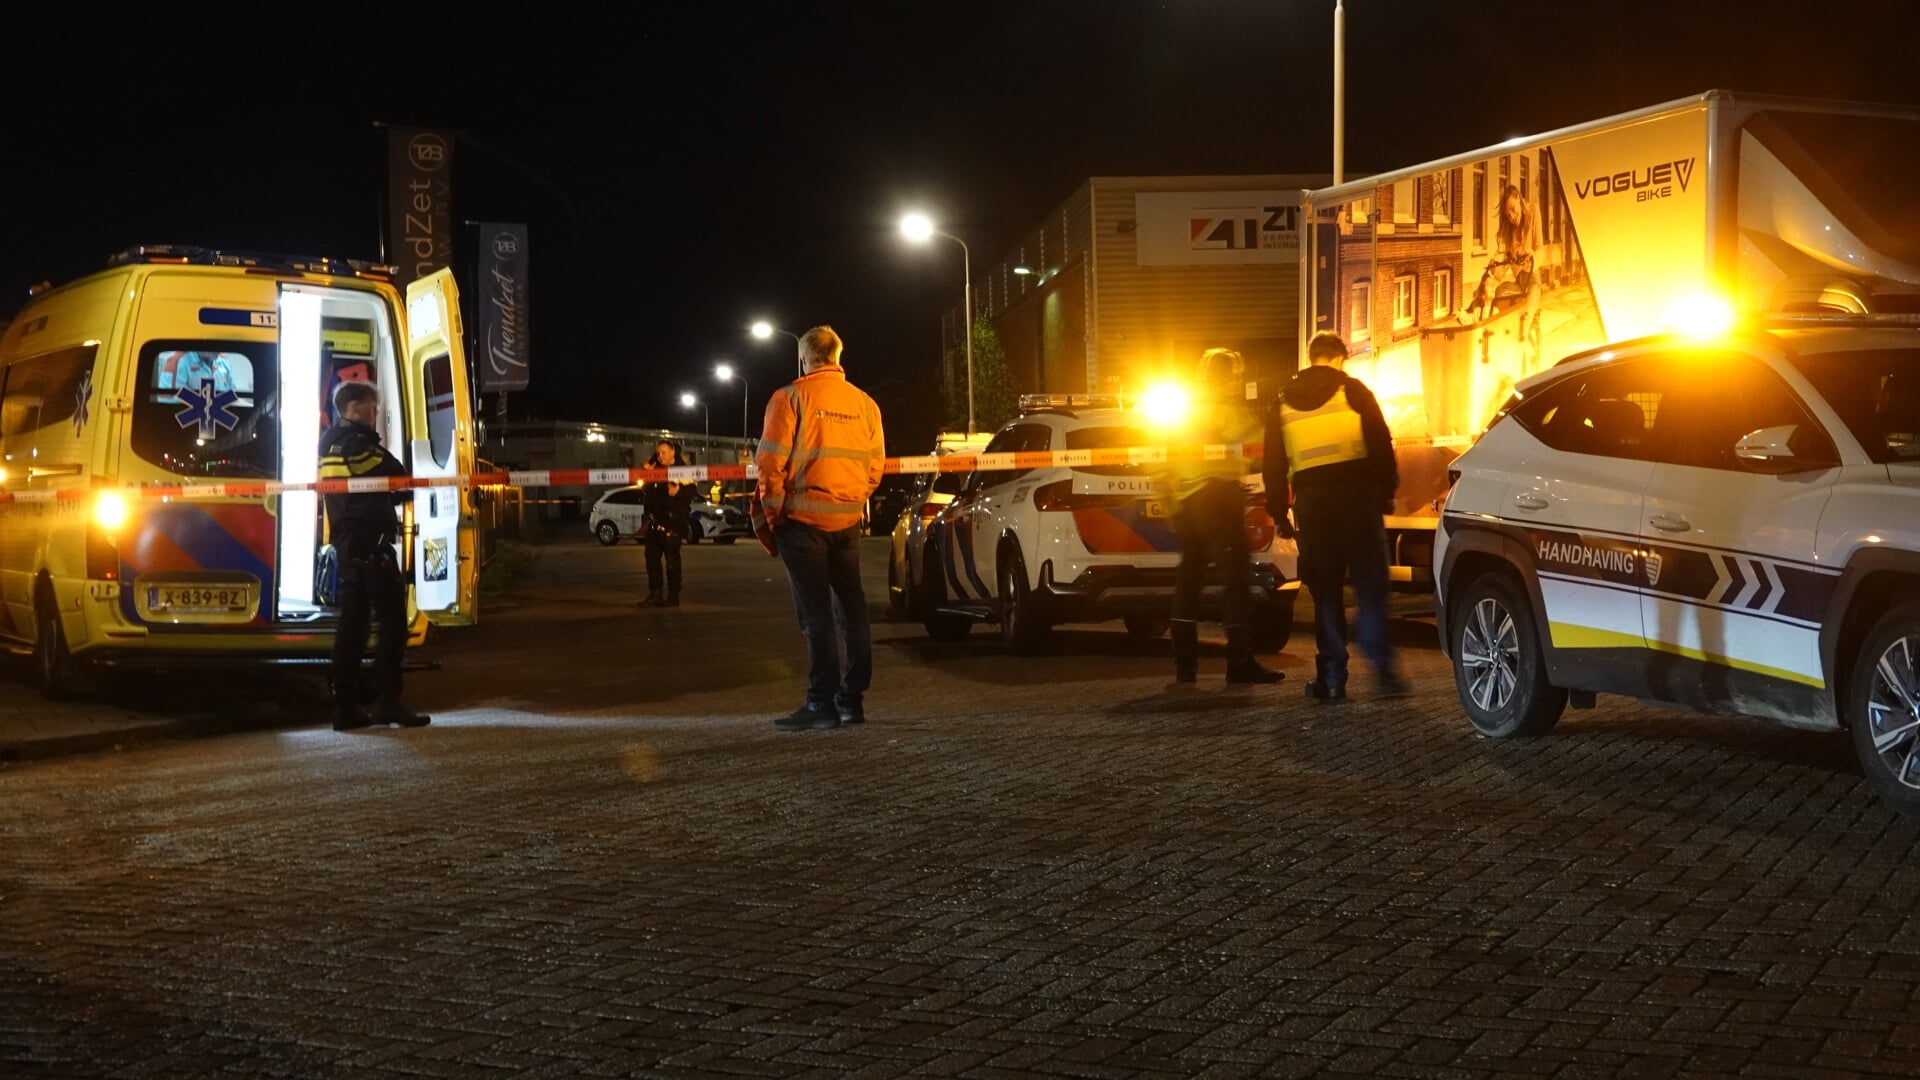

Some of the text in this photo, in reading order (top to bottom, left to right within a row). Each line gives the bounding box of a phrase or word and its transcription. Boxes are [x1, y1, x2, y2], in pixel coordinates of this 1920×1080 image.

[1574, 162, 1672, 200] VOGUE
[1636, 186, 1672, 202] BIKE
[487, 262, 527, 376] Trendzet
[1539, 540, 1634, 574] HANDHAVING
